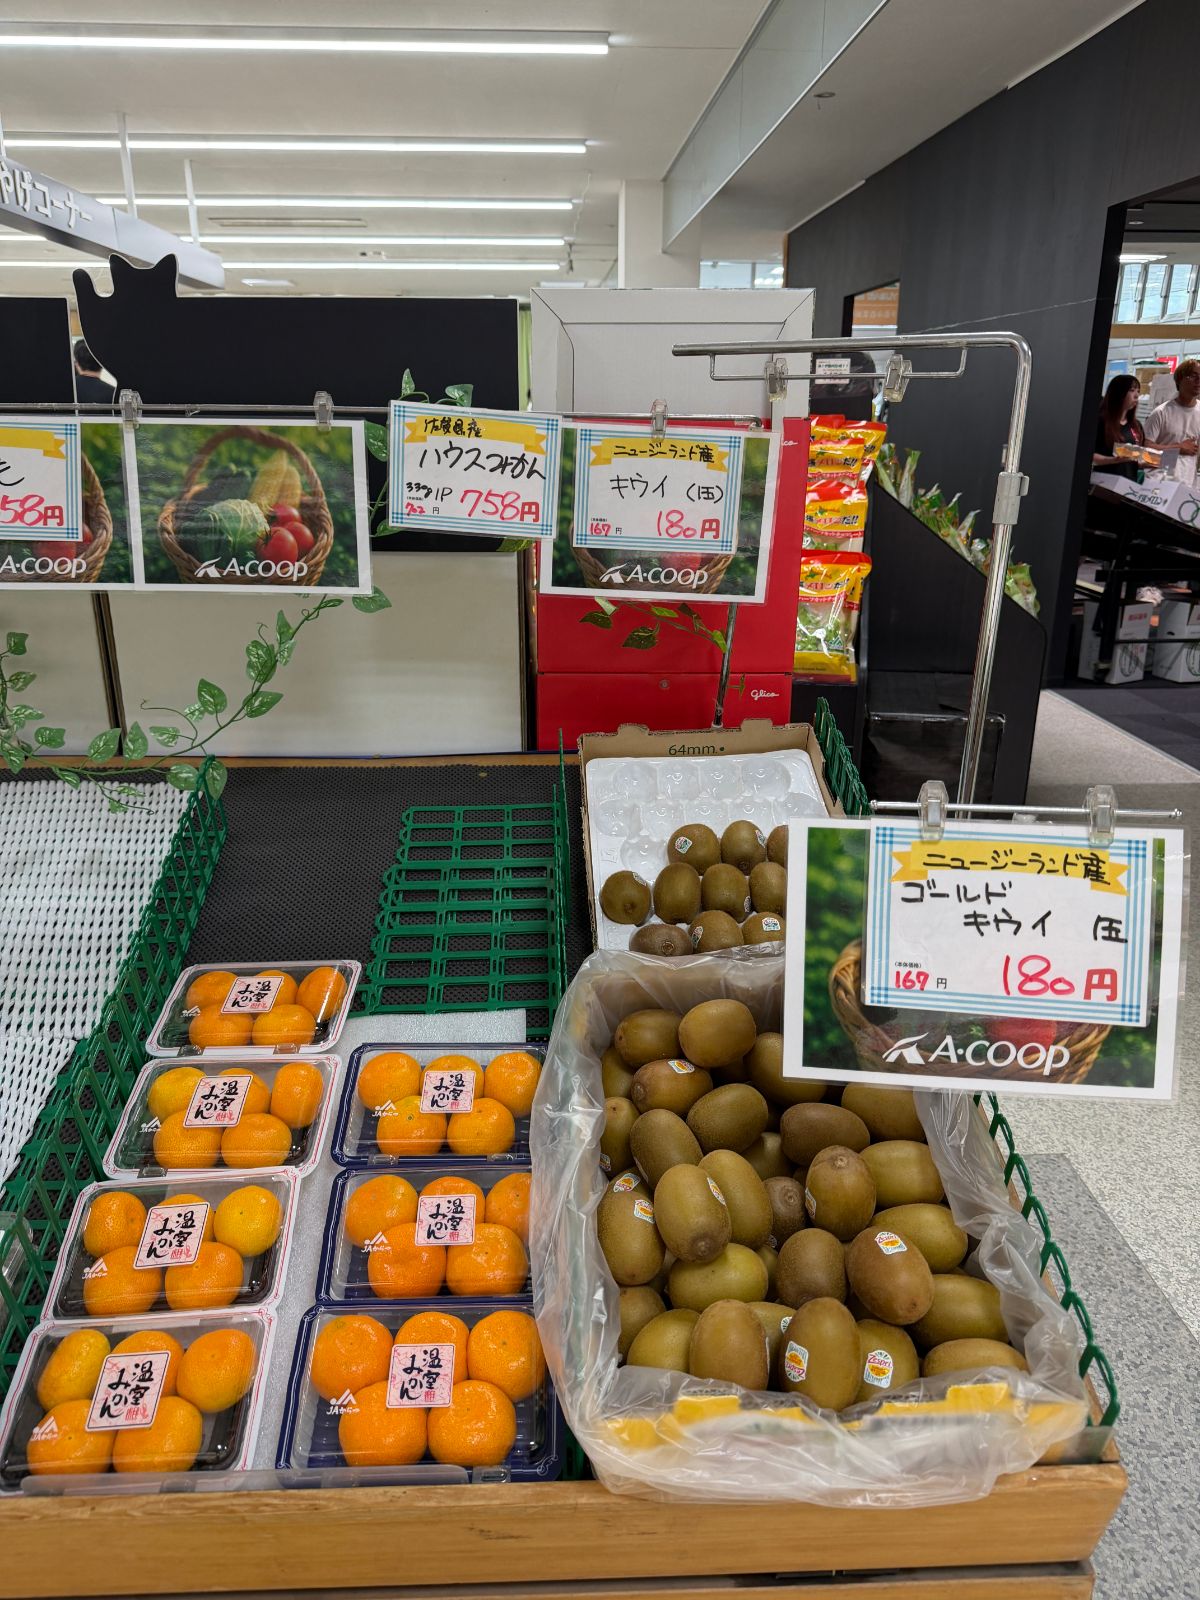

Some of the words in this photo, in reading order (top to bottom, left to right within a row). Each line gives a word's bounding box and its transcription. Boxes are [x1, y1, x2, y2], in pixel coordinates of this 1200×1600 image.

[424, 416, 482, 438] 佐賀県産
[419, 440, 546, 480] ハウスみかん
[613, 442, 715, 463] ニュージーランド産
[610, 473, 668, 499] キウイ
[459, 489, 540, 523] 758円
[590, 523, 611, 537] 167
[656, 509, 721, 540] 180円
[751, 689, 779, 701] Glico
[922, 849, 1111, 885] ニュージーランド産
[900, 879, 1013, 904] ゴールド
[963, 908, 1052, 937] キウイ
[252, 980, 272, 1003] 温室
[894, 970, 930, 991] 167
[936, 977, 947, 989] 円
[1002, 954, 1119, 1002] 180円
[231, 984, 255, 1008] みかん
[194, 1085, 220, 1119] みかん
[217, 1080, 239, 1112] 温室
[431, 1077, 451, 1108] みかん
[449, 1074, 466, 1101] 温室
[173, 1210, 196, 1248] 温室
[427, 1203, 448, 1239] みかん
[447, 1198, 465, 1231] 温室
[146, 1218, 175, 1258] みかん
[129, 1360, 154, 1405] 温室
[400, 1354, 423, 1401] みかん
[422, 1347, 443, 1389] 温室
[100, 1368, 131, 1418] みかん
